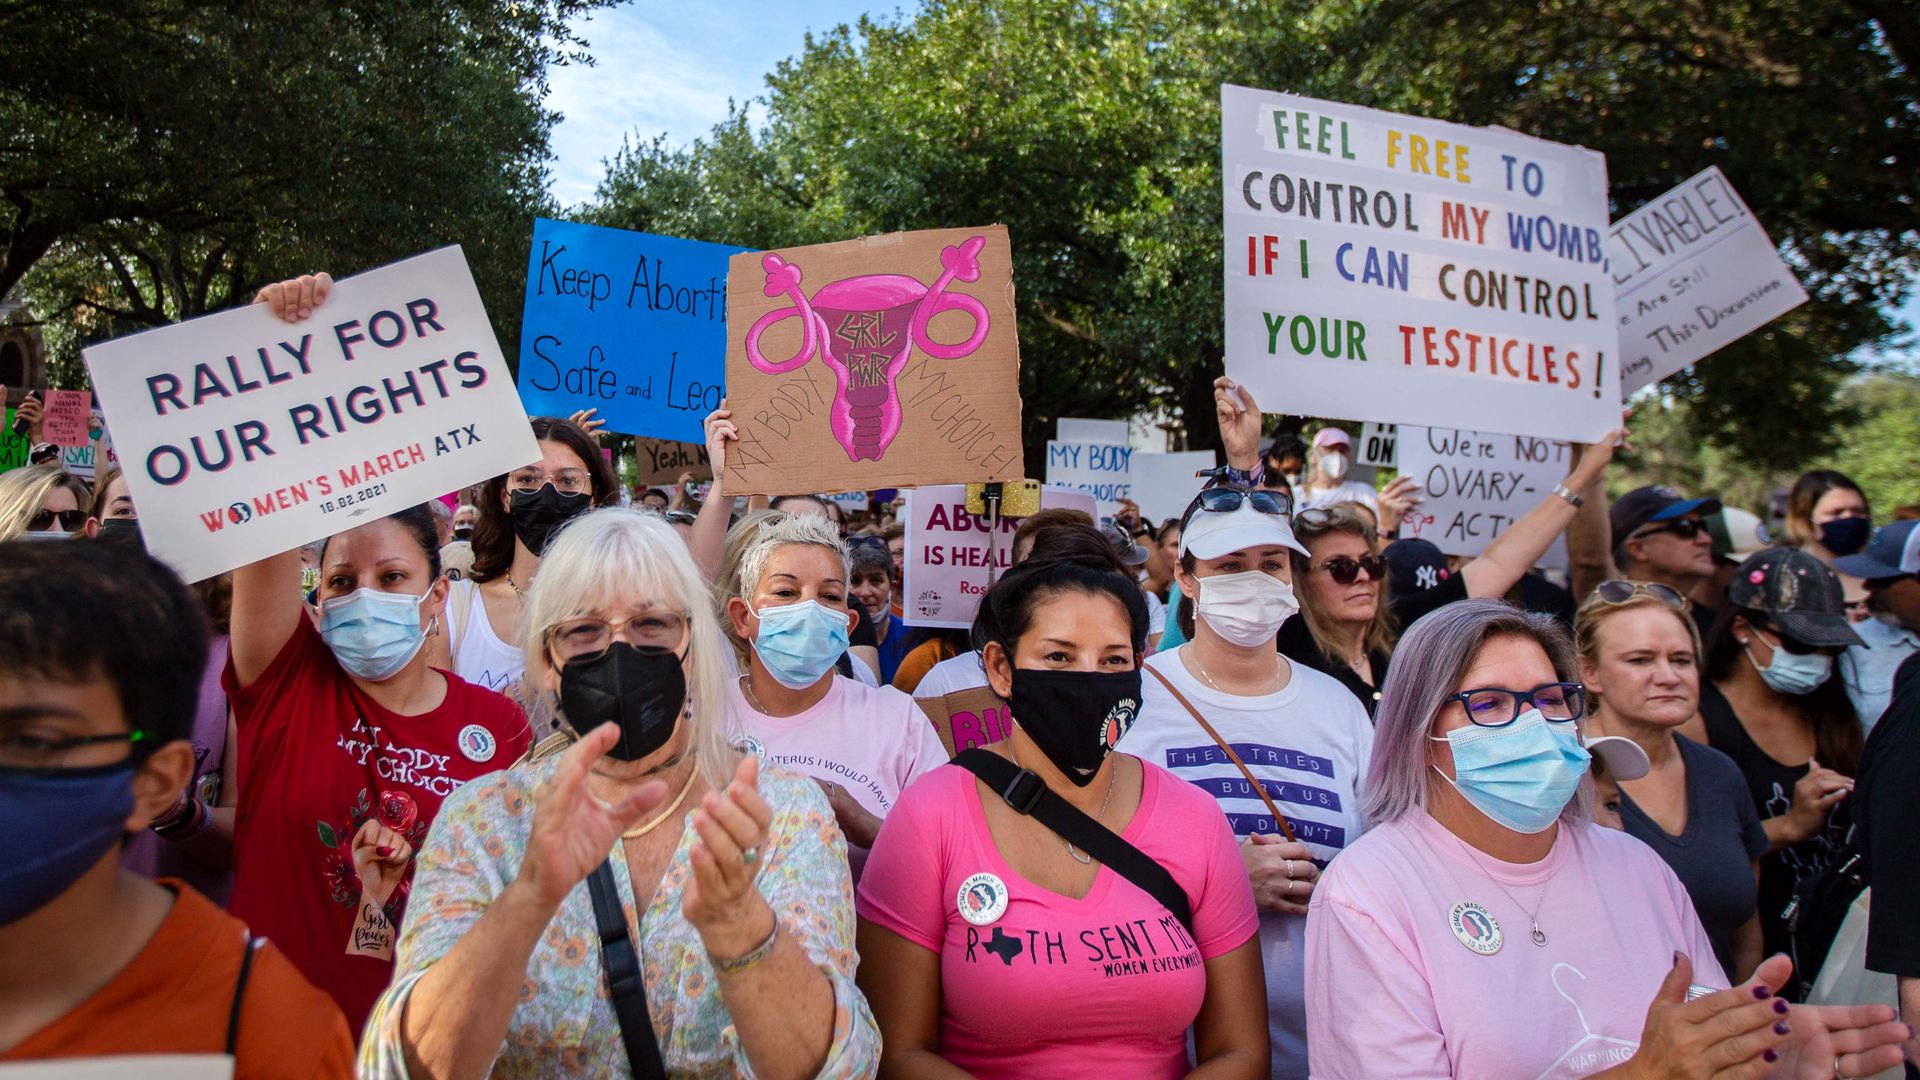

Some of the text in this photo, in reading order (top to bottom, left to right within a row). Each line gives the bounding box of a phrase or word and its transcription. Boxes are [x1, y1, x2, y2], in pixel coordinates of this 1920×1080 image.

[1273, 110, 1544, 197] FEEL FREE TO
[1242, 170, 1609, 274] CONTROL MY WOMB,
[537, 240, 611, 312] Keep
[1248, 235, 1599, 321] IF I CAN CONTROL
[1637, 294, 1668, 317] Are
[836, 310, 898, 350] GRL
[1646, 322, 1699, 353] This
[145, 298, 446, 416] RALLY FOR
[845, 352, 892, 390] PWR
[1263, 311, 1604, 399] YOUR TESTICLES!
[530, 335, 727, 430] Safe and Leg
[146, 350, 489, 487] OUR RIGHTS
[729, 367, 825, 484] MY BODY
[899, 359, 1018, 481] MY CHOICE!
[338, 443, 426, 489] MARCH
[434, 423, 482, 457] ATX
[1050, 444, 1133, 473] MY BODY
[1366, 436, 1395, 464] ON
[1427, 426, 1571, 463] We're NOT
[1444, 511, 1514, 542] ACT
[924, 545, 945, 566] IS
[1169, 748, 1320, 771] THEY TRIED
[817, 758, 822, 767] I
[824, 759, 869, 784] WOULD
[867, 781, 893, 811] HAVE
[1258, 819, 1331, 840] DIDN'T
[363, 903, 390, 931] Girl
[355, 927, 389, 952] Power
[1080, 919, 1157, 963] SENT
[1103, 960, 1149, 978] WOMEN
